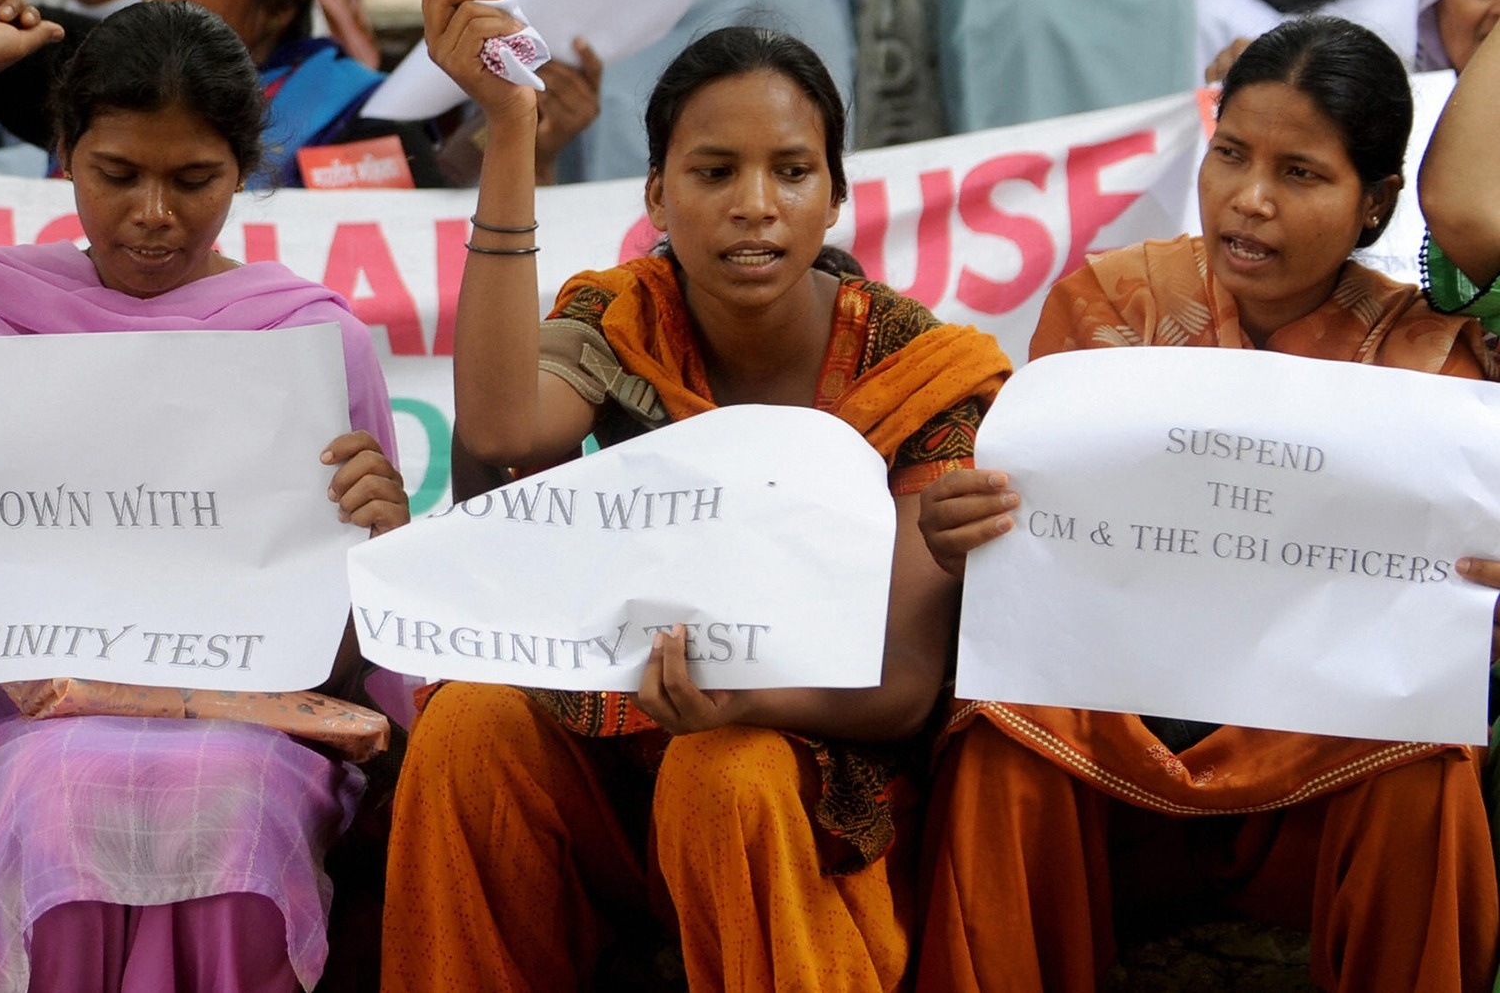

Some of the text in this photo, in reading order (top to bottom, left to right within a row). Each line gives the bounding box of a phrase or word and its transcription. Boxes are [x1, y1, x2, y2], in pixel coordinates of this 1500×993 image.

[1164, 426, 1325, 473] SUSPEND
[105, 482, 222, 529] WITH
[594, 485, 724, 531] WITH
[1206, 481, 1274, 515] THE
[1028, 510, 1451, 583] CM & THE CBI OFFICERS
[142, 631, 266, 671] TEST
[358, 606, 632, 670] VIRGINITY
